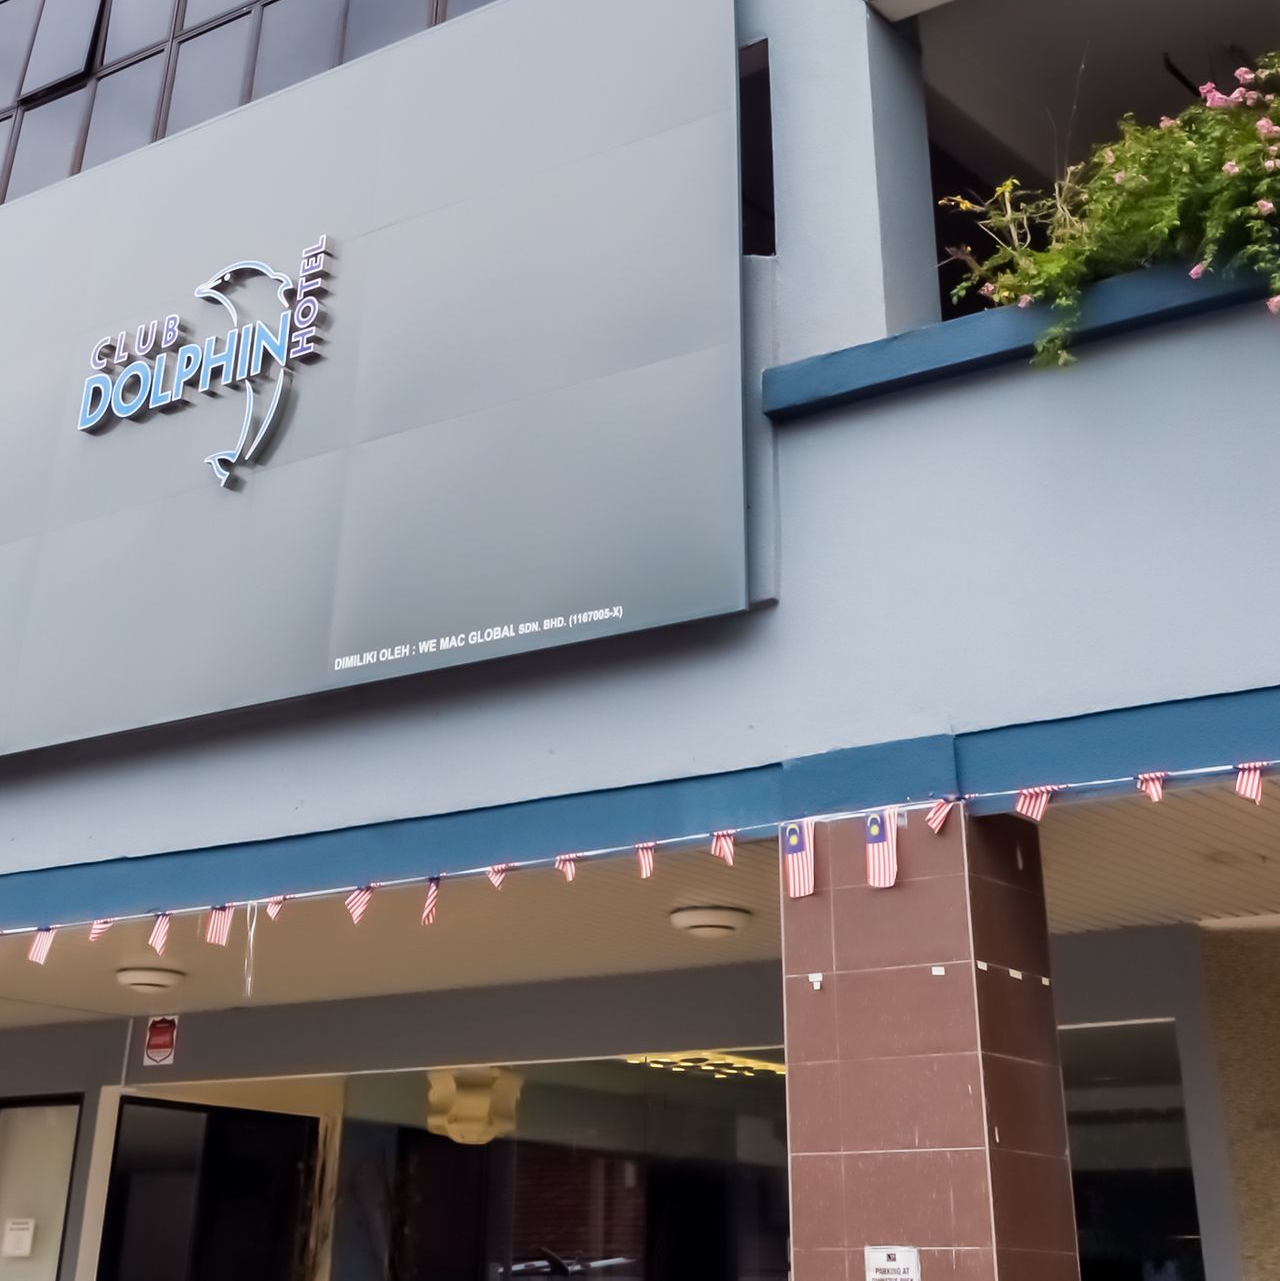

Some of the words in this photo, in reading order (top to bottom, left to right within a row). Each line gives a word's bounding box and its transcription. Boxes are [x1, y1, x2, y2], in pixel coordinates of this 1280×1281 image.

[289, 234, 328, 358] HOTEL
[77, 309, 292, 431] DOLPHIN
[90, 314, 181, 370] CLUB
[334, 651, 377, 671] DIMILIKI
[379, 644, 410, 662] OLEH
[418, 639, 437, 654] WE
[439, 633, 466, 650] MAC
[468, 624, 516, 645] GLOBAL
[518, 621, 541, 635] SDN.
[543, 616, 567, 630] BHD.
